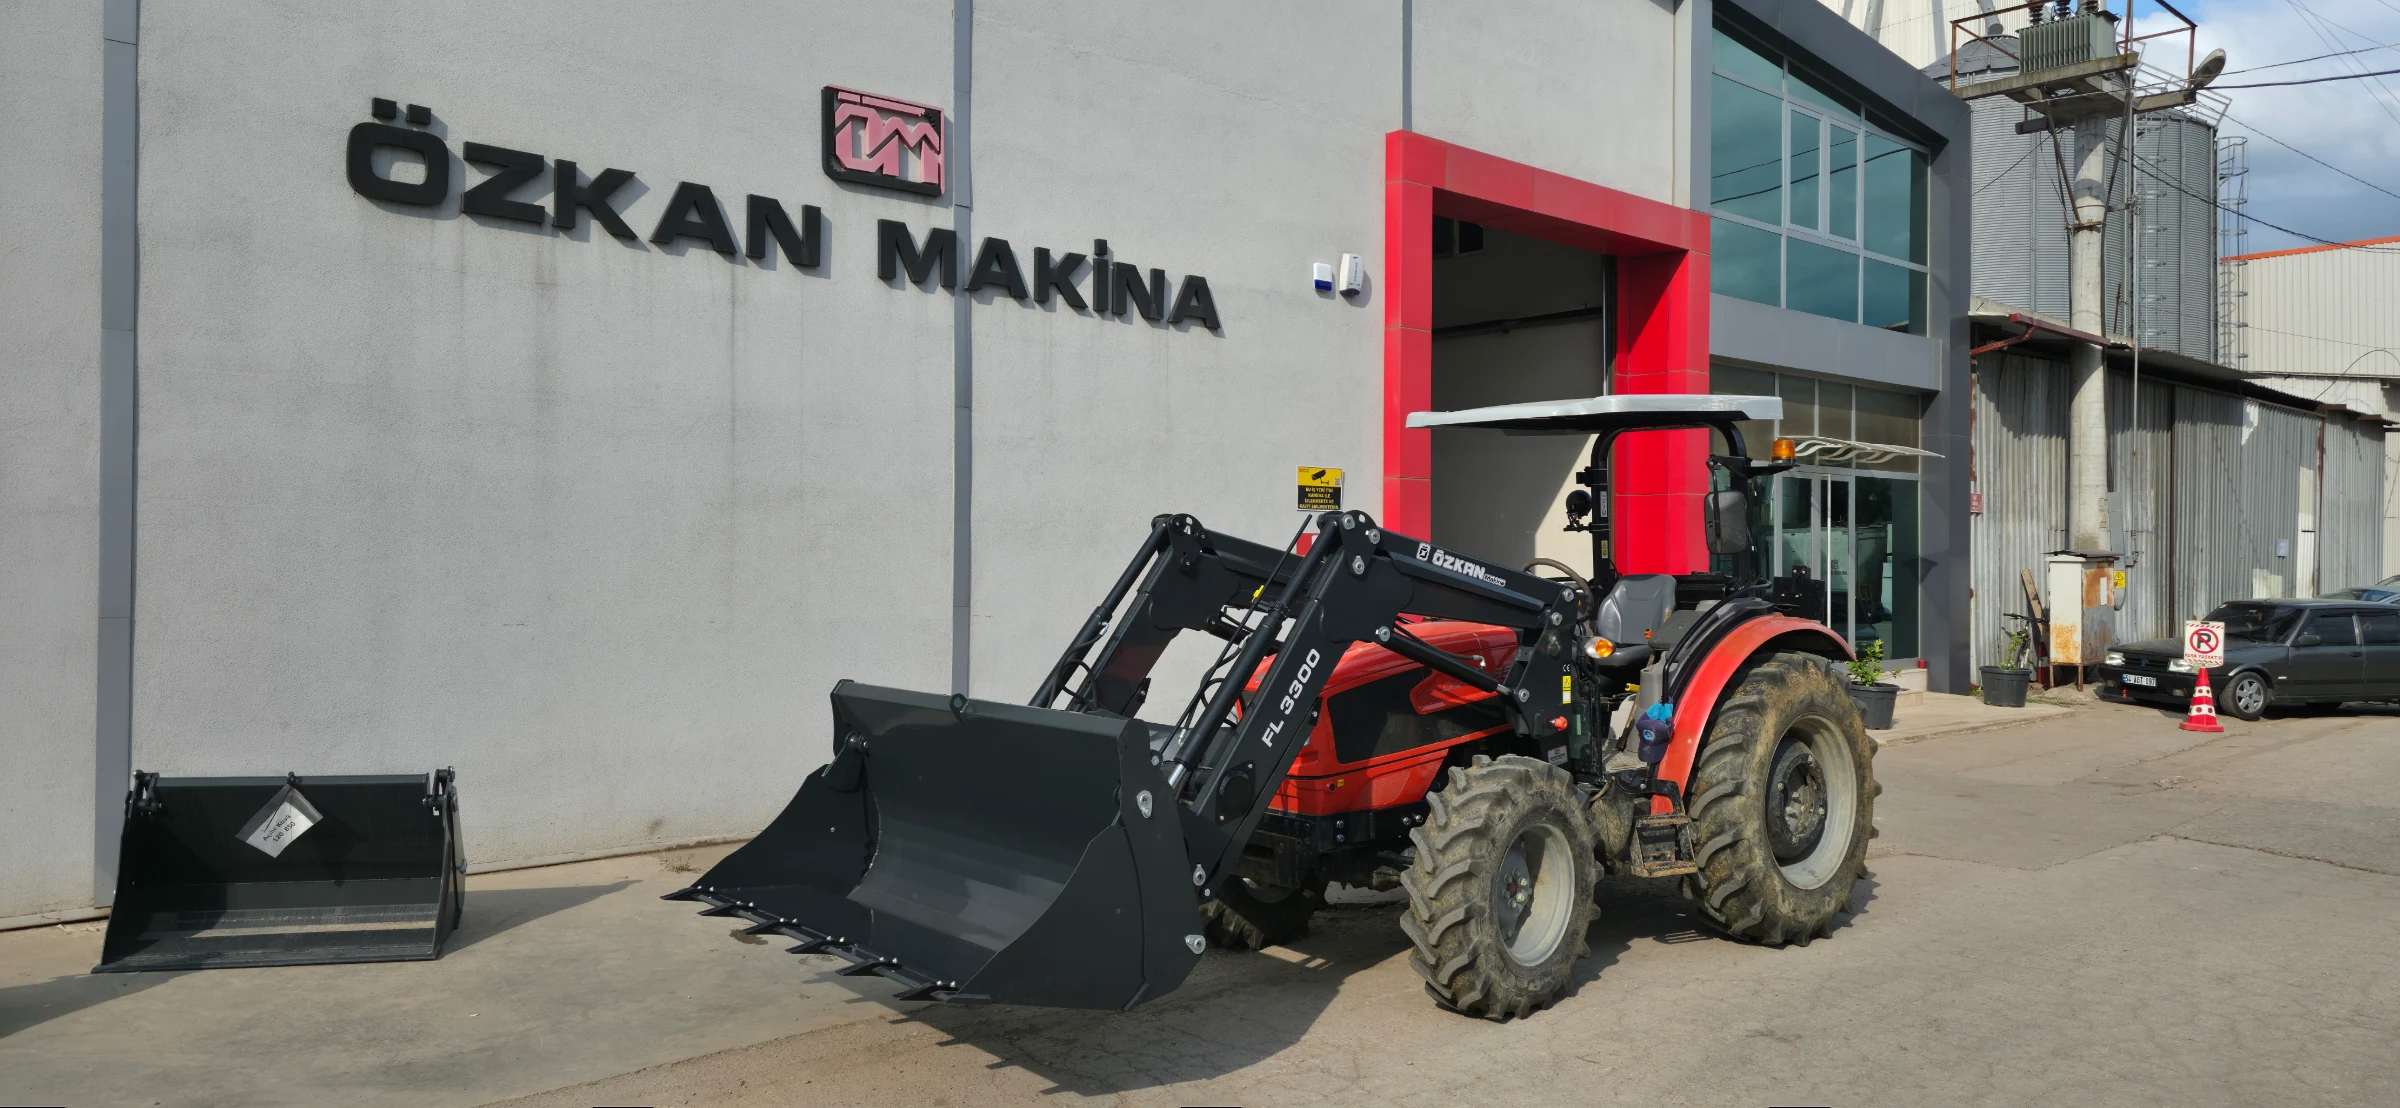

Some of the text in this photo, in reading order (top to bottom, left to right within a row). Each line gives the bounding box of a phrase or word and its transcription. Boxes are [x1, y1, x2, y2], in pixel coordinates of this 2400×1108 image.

[346, 97, 1221, 330] ÖZKAN MAKİNA
[1432, 549, 1486, 580] ÖZKAN
[1261, 648, 1321, 748] FL 3300
[273, 821, 296, 842] 120 850
[276, 814, 291, 828] Kova
